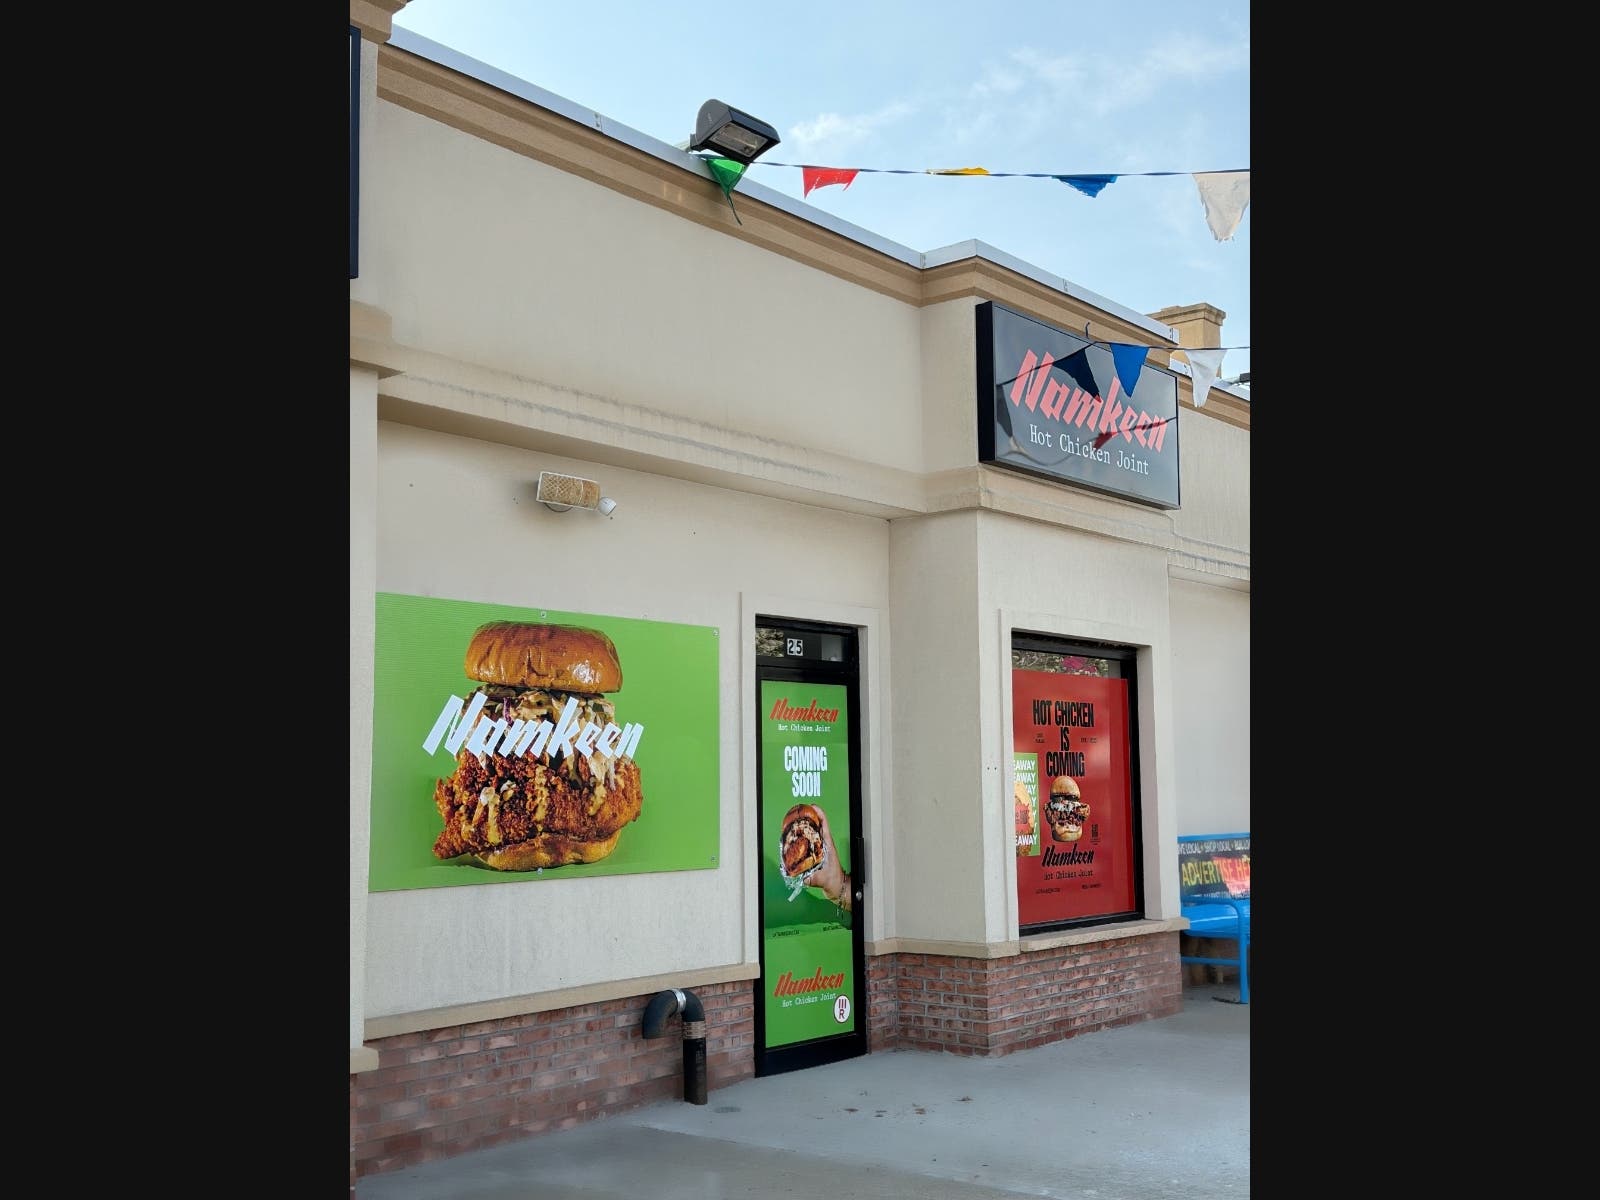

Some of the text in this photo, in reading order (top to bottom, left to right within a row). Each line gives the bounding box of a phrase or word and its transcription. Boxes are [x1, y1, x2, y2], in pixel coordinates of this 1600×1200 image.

[1010, 349, 1168, 453] Namkeen
[1029, 424, 1149, 475] Hot Chicken Joint
[788, 639, 803, 655] 25
[769, 698, 839, 722] Namkeen
[1032, 699, 1094, 728] HOT CHICKEN
[422, 691, 644, 759] Namkeen
[1060, 726, 1070, 751] IS
[784, 745, 828, 771] COMING
[1046, 751, 1085, 777] COMING
[791, 771, 821, 797] SOON
[1042, 843, 1094, 867] Namkeen
[774, 967, 845, 998] Namkeen
[795, 995, 818, 1005] Chicken
